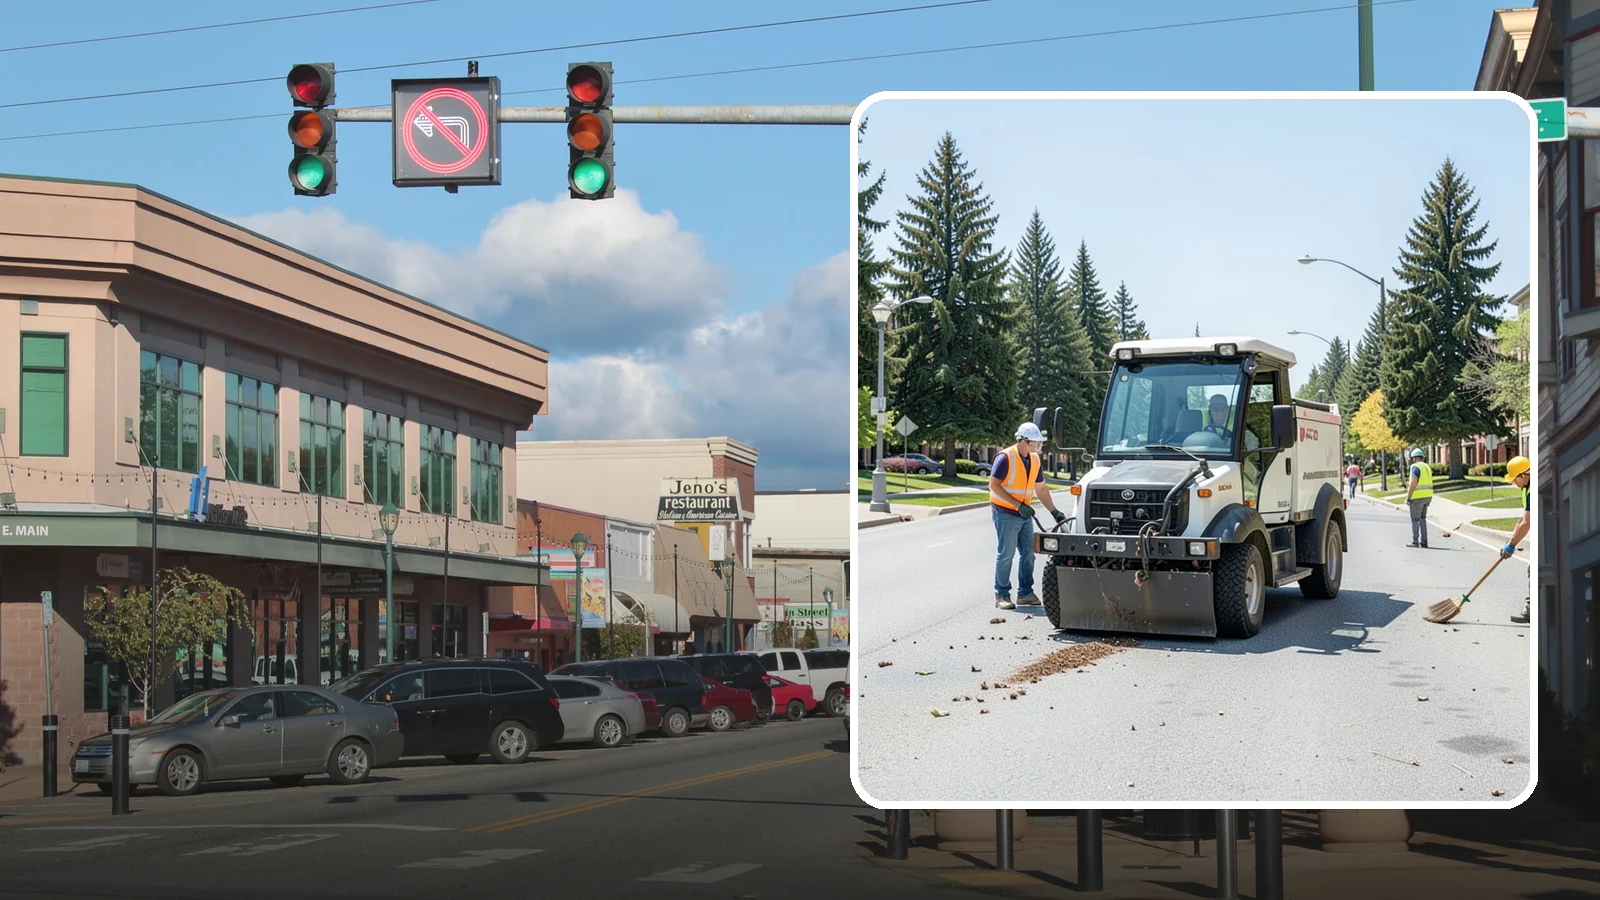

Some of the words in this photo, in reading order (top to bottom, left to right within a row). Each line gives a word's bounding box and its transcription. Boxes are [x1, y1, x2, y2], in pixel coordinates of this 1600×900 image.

[670, 480, 727, 494] Jeno's
[665, 496, 731, 509] restaurant
[659, 510, 681, 519] Italian
[686, 509, 714, 519] American
[715, 509, 737, 519] Cuisine
[2, 525, 13, 536] E.
[16, 525, 49, 536] MAIN
[797, 608, 828, 616] Street
